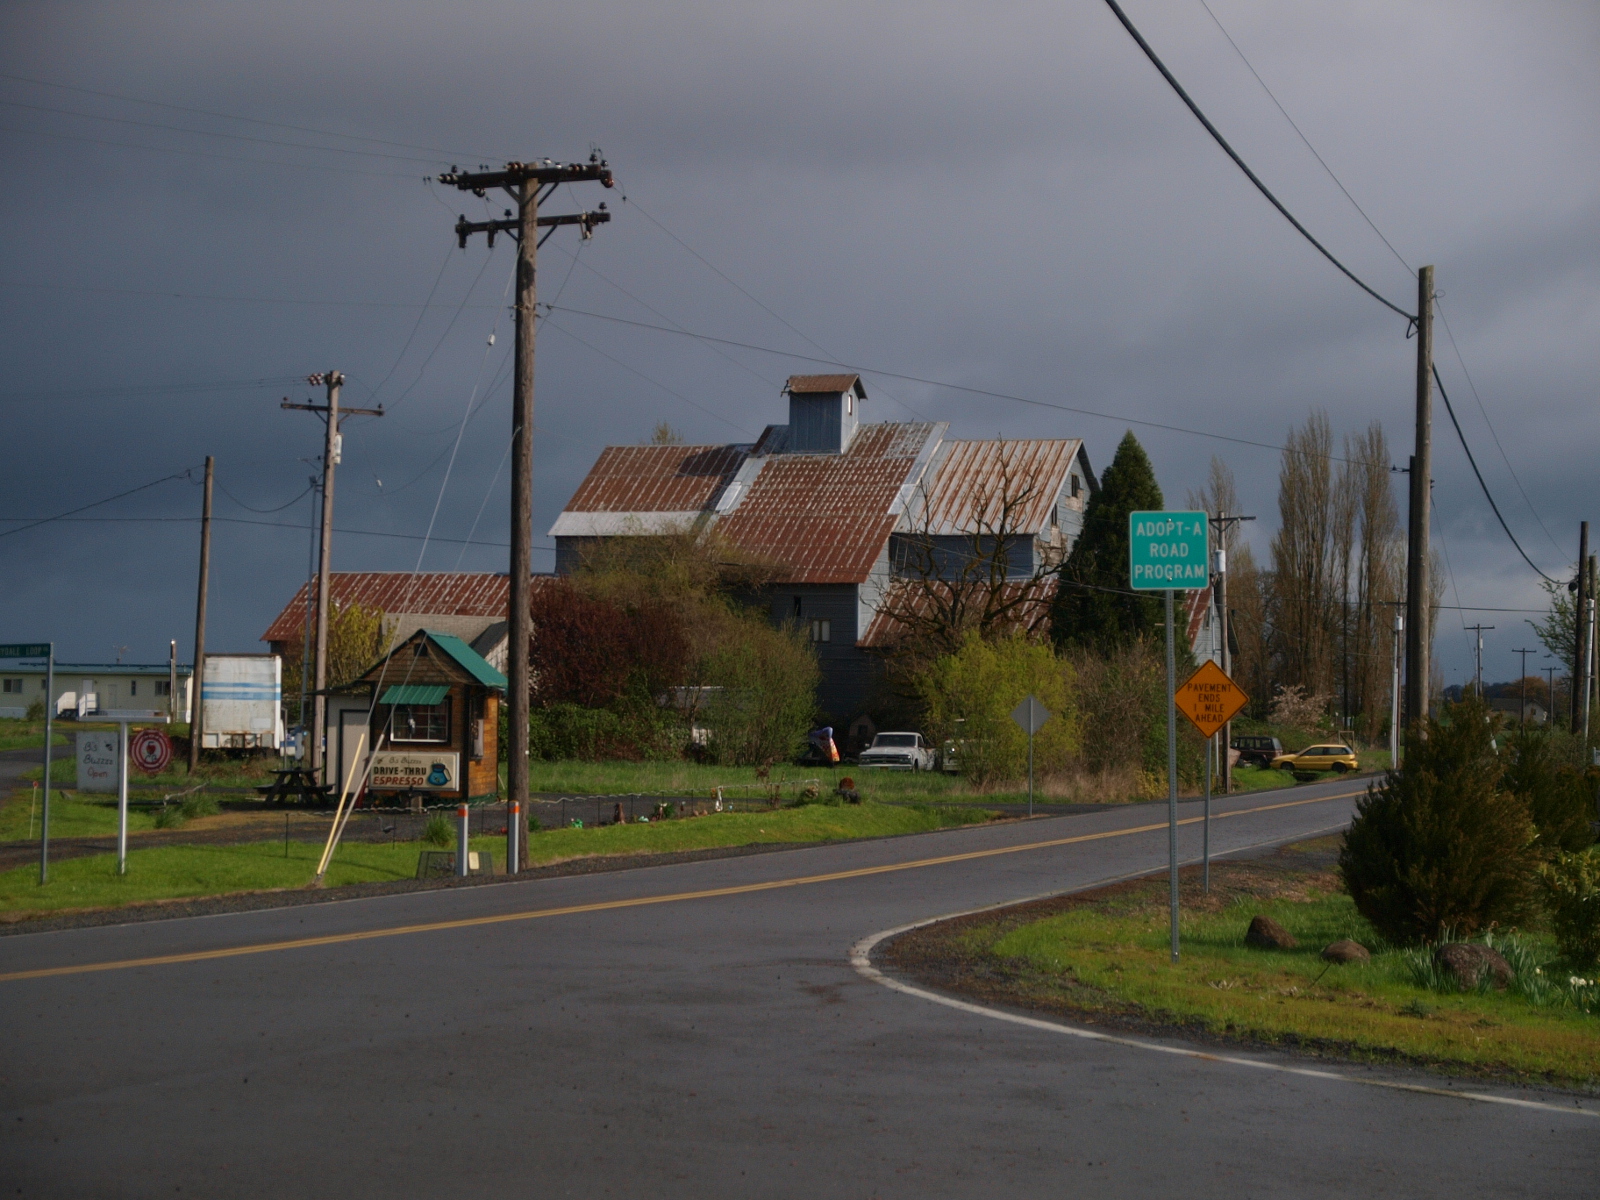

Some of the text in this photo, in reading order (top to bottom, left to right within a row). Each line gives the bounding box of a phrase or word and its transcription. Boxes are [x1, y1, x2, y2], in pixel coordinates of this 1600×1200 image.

[1136, 522, 1203, 537] ADOPT-A
[1149, 542, 1189, 558] ROAD
[1134, 564, 1205, 580] PROGRAM
[1187, 683, 1232, 693] PAVEMENT
[1198, 694, 1221, 703] ENDS
[1204, 704, 1225, 713] MILE
[1195, 714, 1224, 723] AHEAD
[373, 776, 424, 786] ESPRESSO
